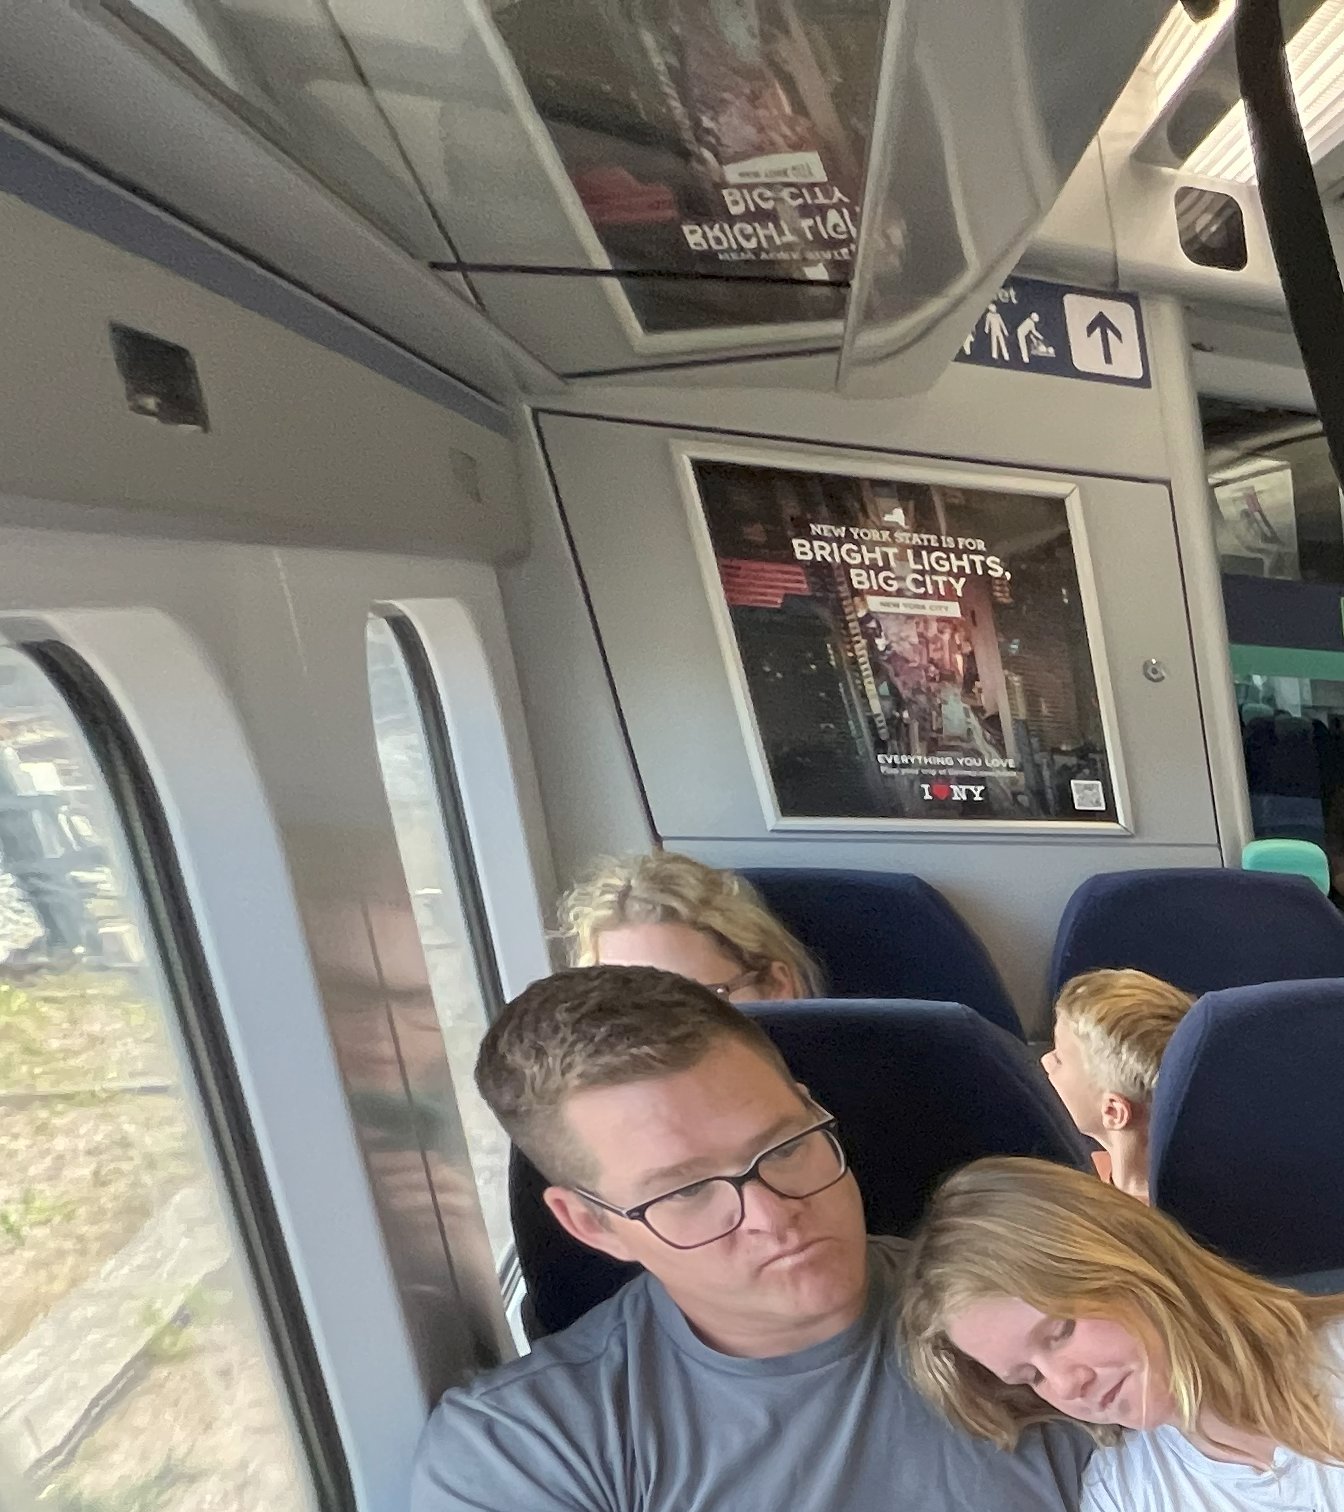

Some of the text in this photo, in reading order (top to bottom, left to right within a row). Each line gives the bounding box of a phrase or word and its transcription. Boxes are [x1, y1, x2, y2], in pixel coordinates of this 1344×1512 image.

[809, 523, 988, 552] NEW YORK STATE IS FOR
[791, 538, 1012, 582] BRIGHT LIGHTS,
[849, 568, 966, 598] BIG CITY
[929, 604, 949, 613] CITY
[876, 753, 1016, 769] EVERYTHING YOU LOVE
[920, 783, 986, 801] I NY
